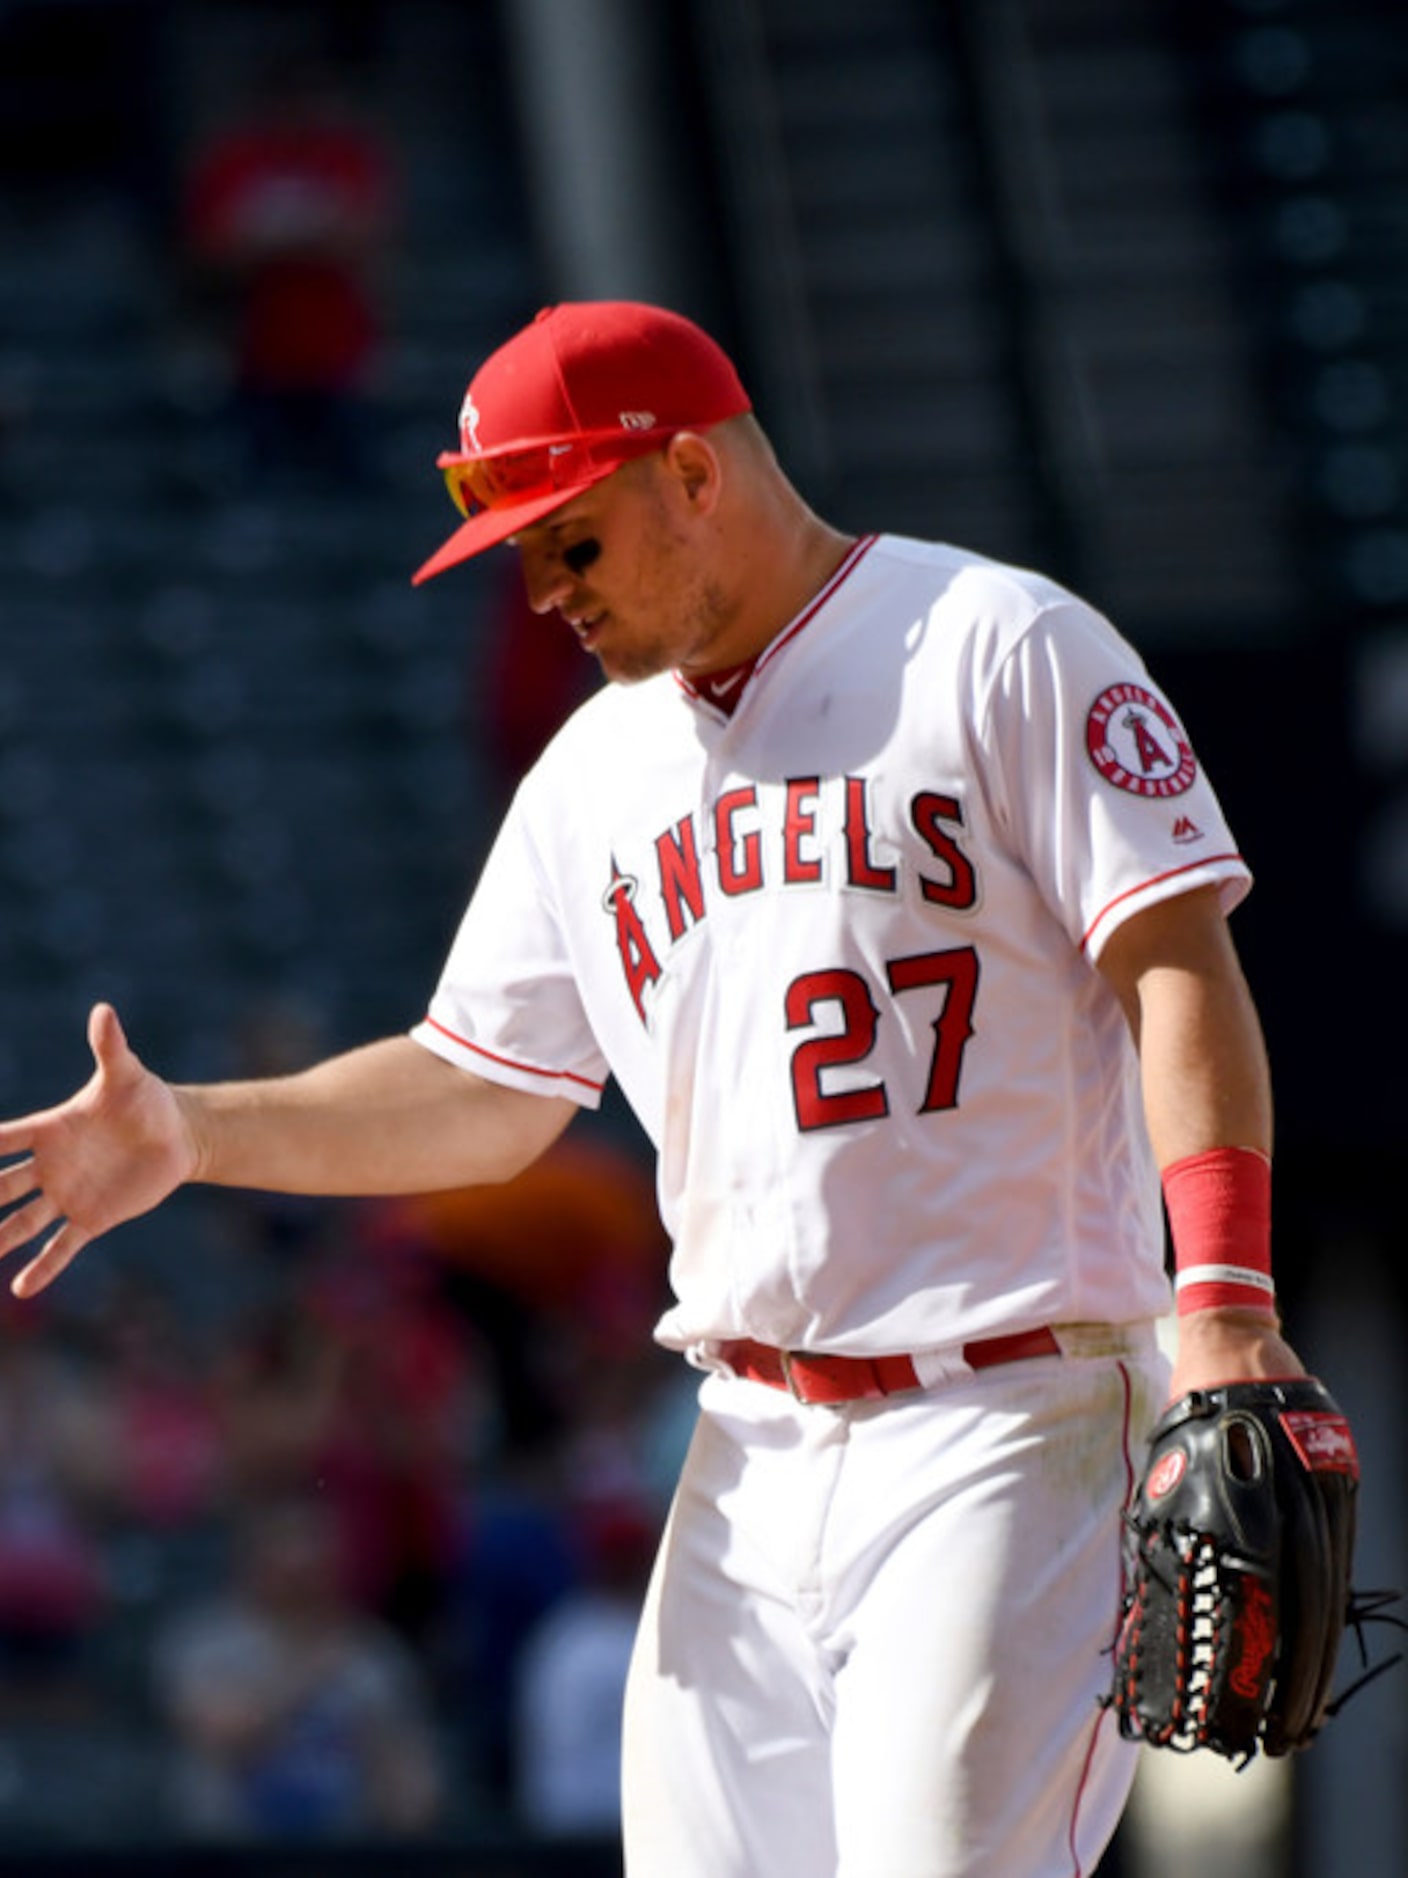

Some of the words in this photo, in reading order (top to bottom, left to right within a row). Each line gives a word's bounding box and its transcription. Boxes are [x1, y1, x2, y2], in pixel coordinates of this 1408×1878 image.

[1121, 706, 1175, 774] A
[602, 775, 977, 1027] ANGELS
[784, 946, 981, 1133] 27
